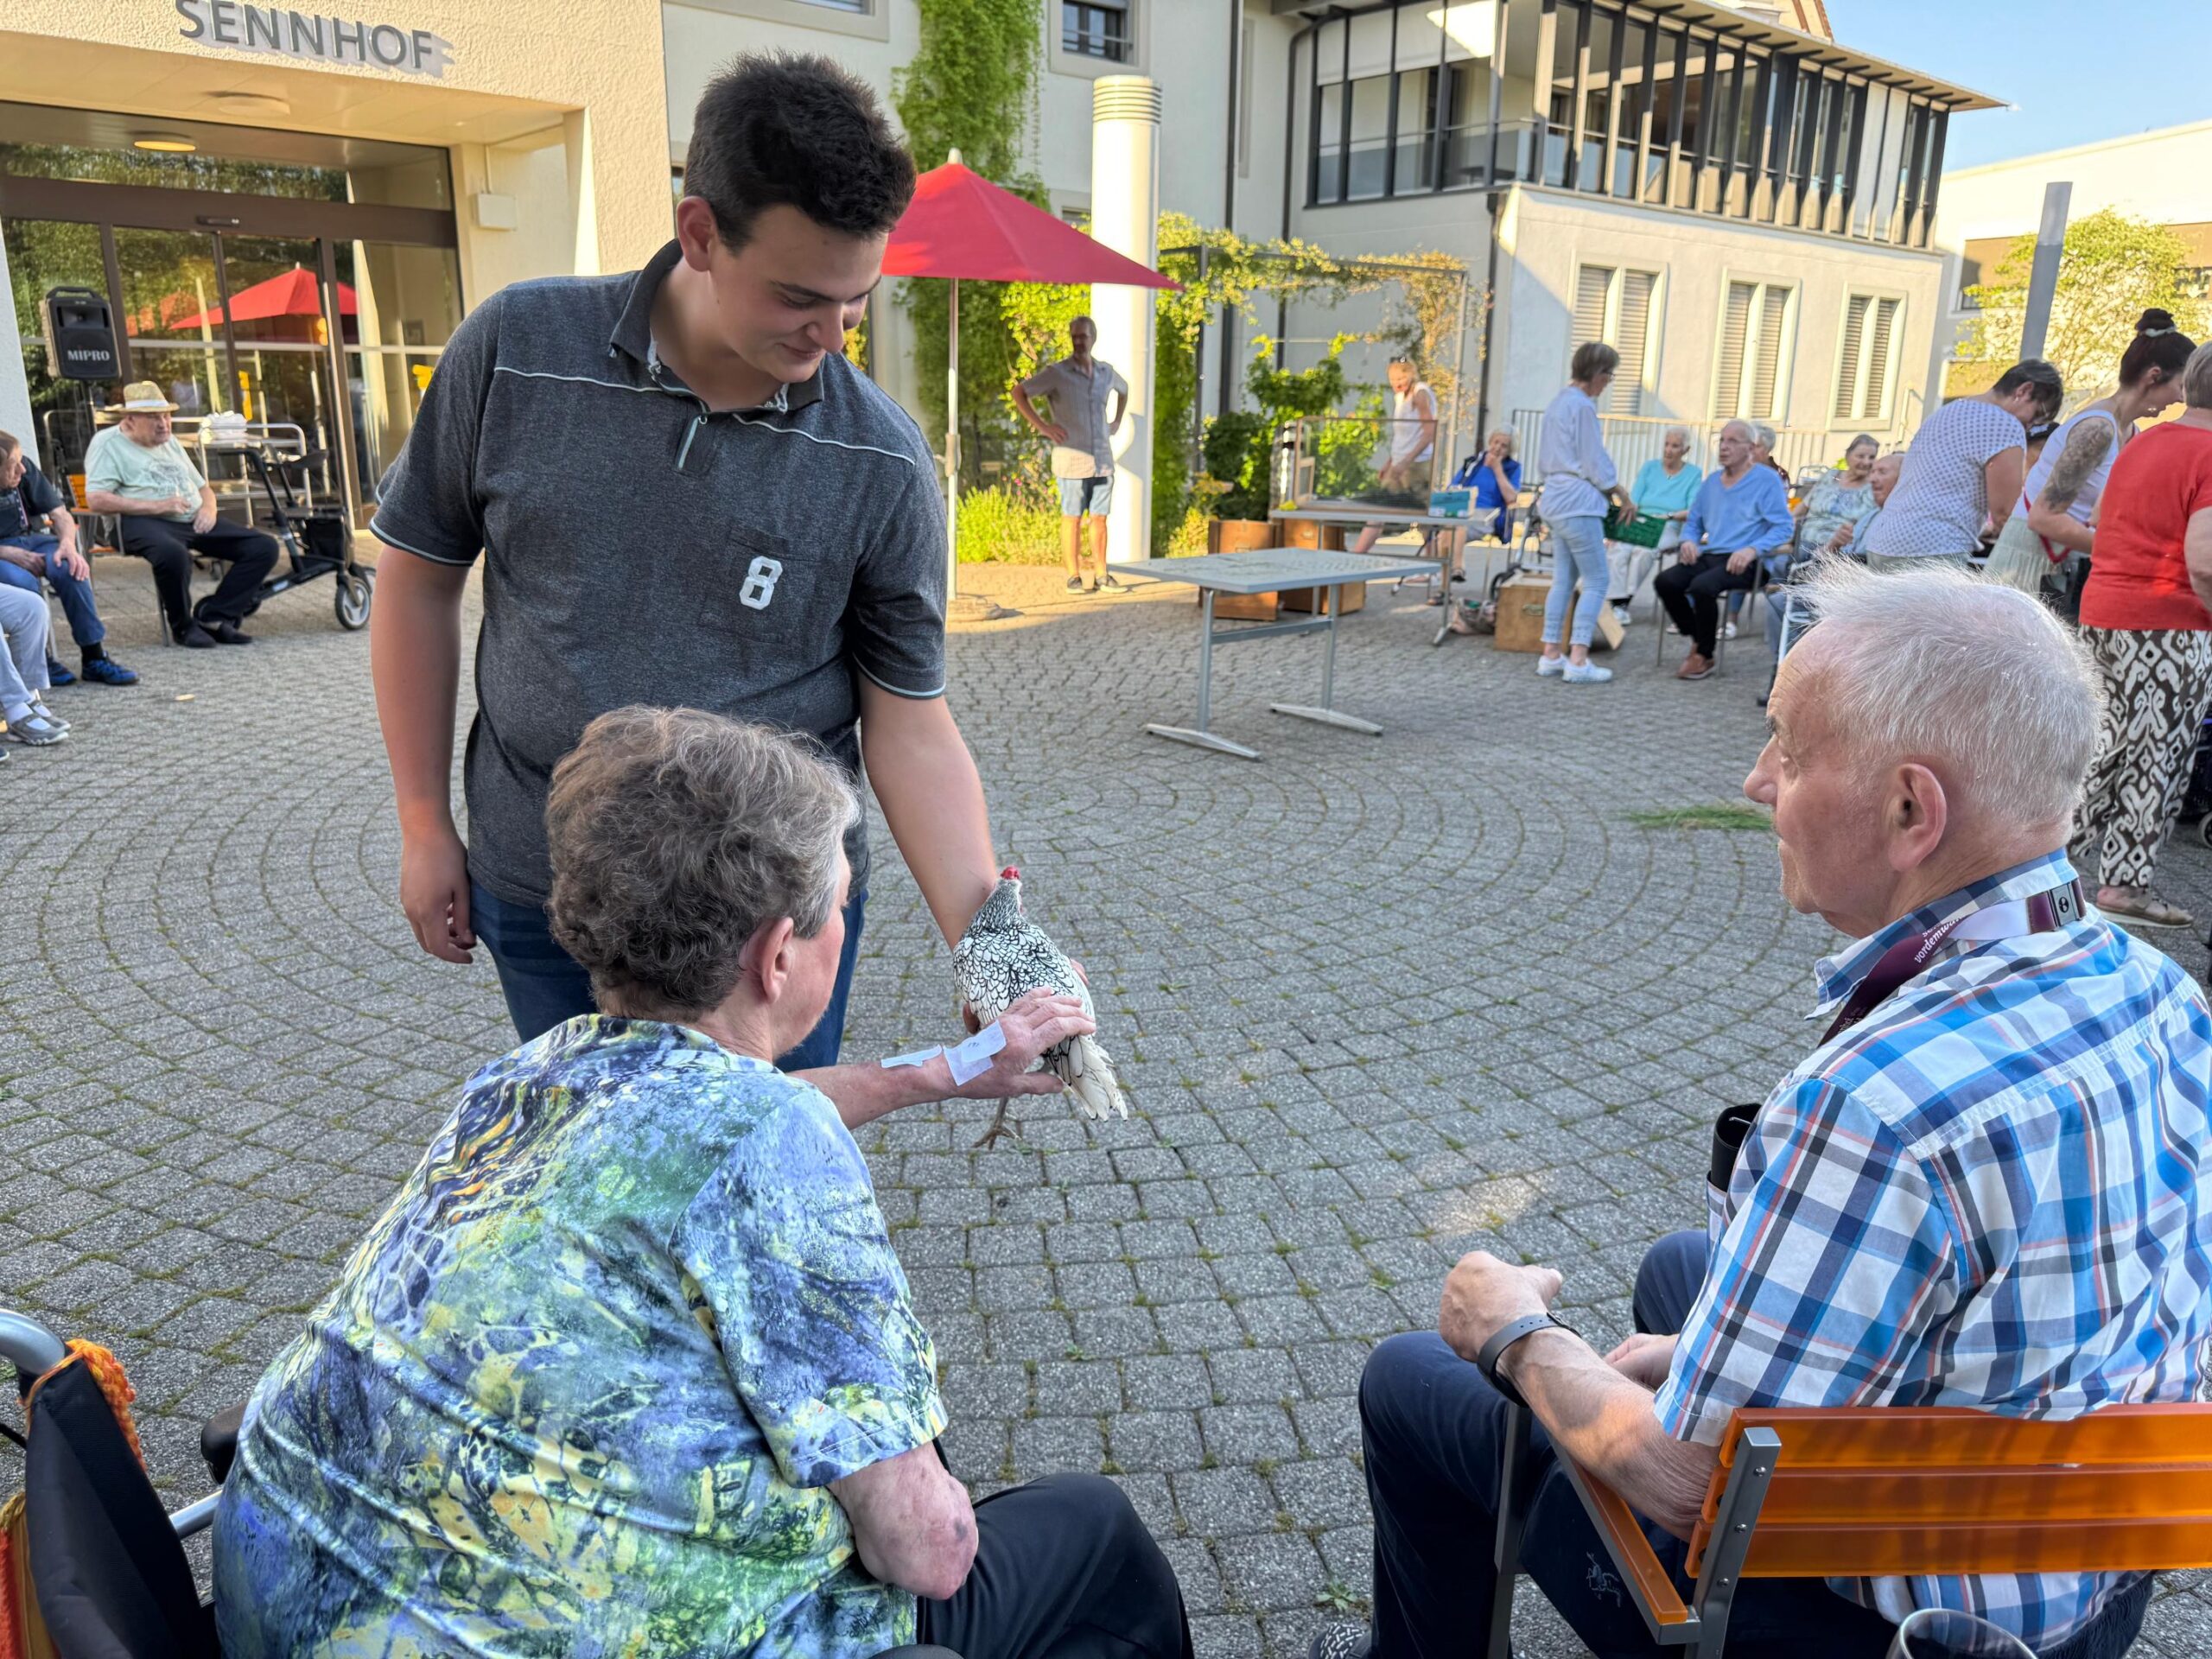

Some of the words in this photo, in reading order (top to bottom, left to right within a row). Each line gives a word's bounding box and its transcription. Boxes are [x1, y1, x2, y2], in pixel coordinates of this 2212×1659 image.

[175, 0, 433, 69] SENNHOF
[67, 349, 111, 361] MIPRO
[739, 556, 783, 610] 8
